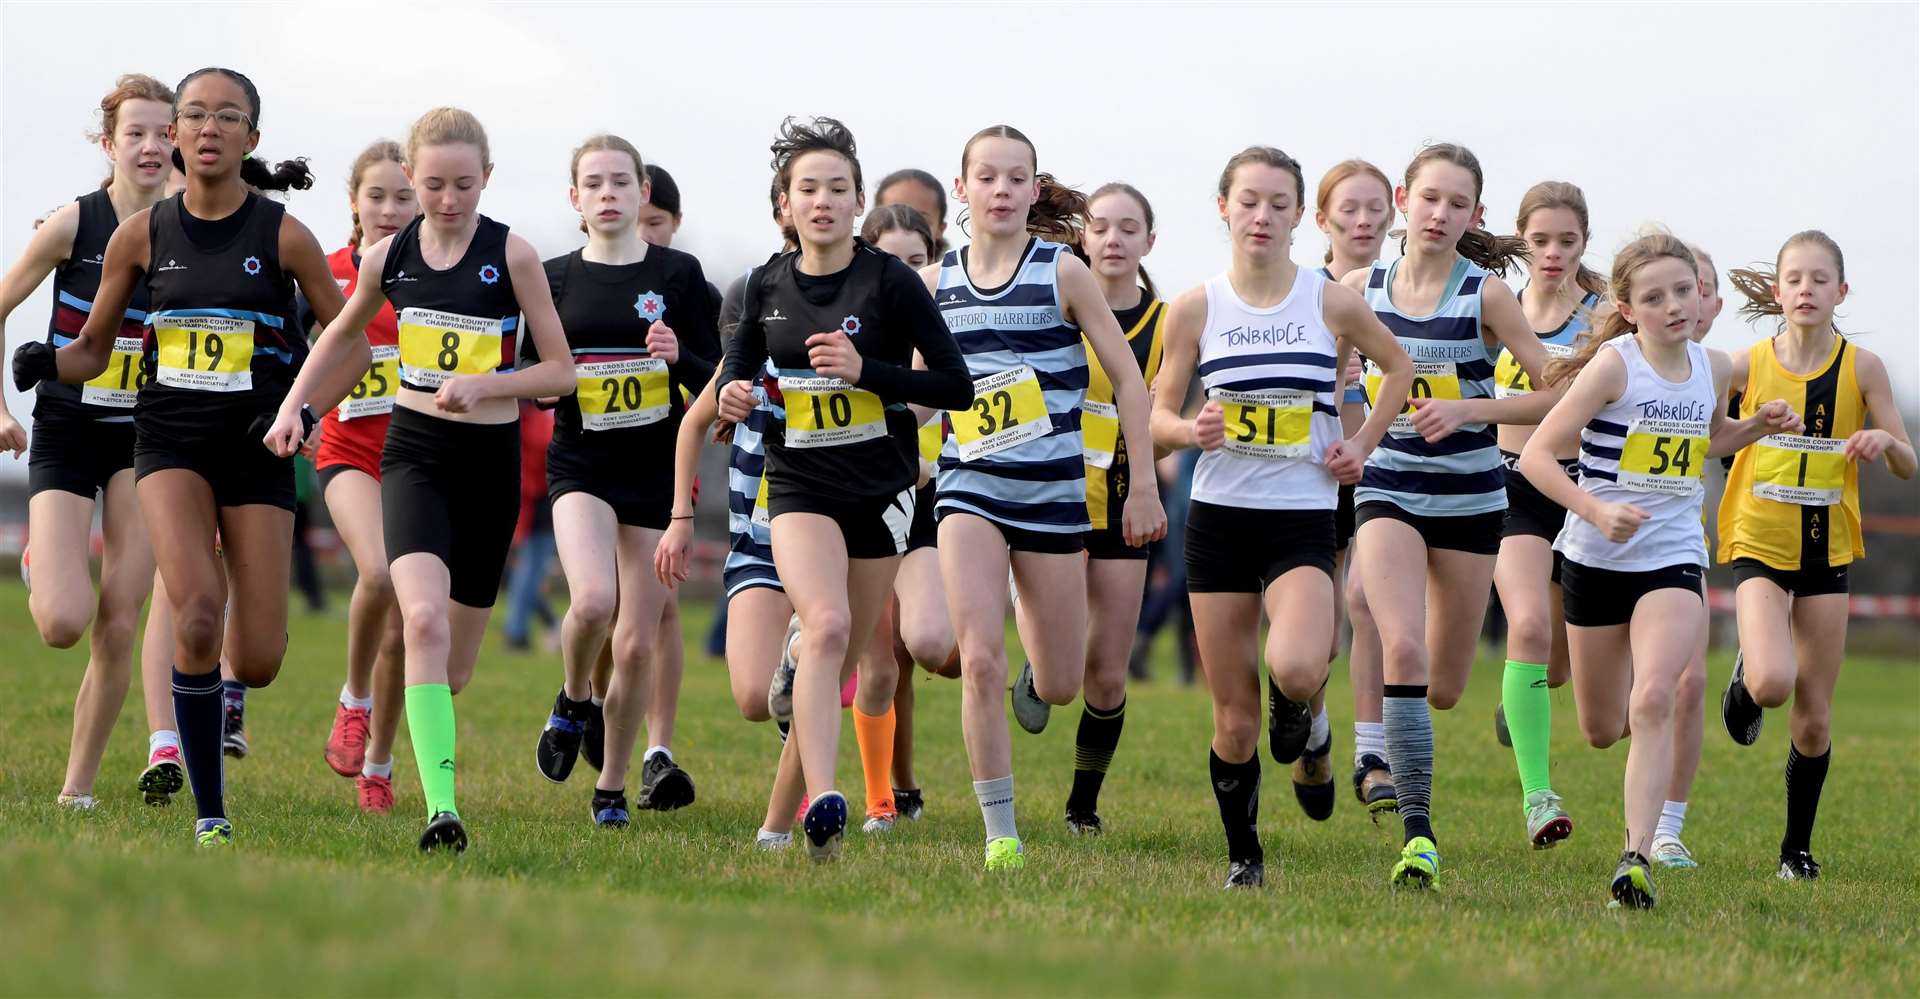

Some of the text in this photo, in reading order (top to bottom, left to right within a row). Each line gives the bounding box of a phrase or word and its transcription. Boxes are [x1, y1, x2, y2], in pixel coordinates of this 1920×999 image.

[210, 319, 244, 327] COUNTRY
[413, 311, 494, 327] KENT CROSS COUNTRY
[994, 311, 1053, 325] HARRIERS
[177, 323, 234, 331] CHAMPIONSHIPS
[425, 319, 486, 333] CHAMPIONSHIPS
[188, 331, 224, 371] 19
[437, 331, 460, 371] 8
[1417, 345, 1473, 359] HARRIERS
[626, 360, 657, 368] COUNTRY
[595, 367, 650, 376] CHAMPIONSHIPS
[991, 367, 1023, 383] COUNTRY
[602, 376, 642, 413] 20
[811, 393, 852, 430] 10
[973, 390, 1019, 436] 32
[1236, 405, 1276, 445] 51
[1650, 427, 1702, 436] CHAMPIONSHIPS
[1659, 421, 1680, 429] CROSS
[825, 433, 864, 442] ASSOCIATION
[968, 431, 1032, 456] ATHLETICS ASSOCIATION
[981, 430, 1019, 446] KENT COUNTY
[1768, 434, 1842, 446] KENT CROSS COUNTRY
[1779, 441, 1834, 451] CHAMPIONSHIPS
[1648, 437, 1691, 477] 54
[1797, 452, 1808, 487] 1
[1627, 481, 1658, 489] ATHLETICS
